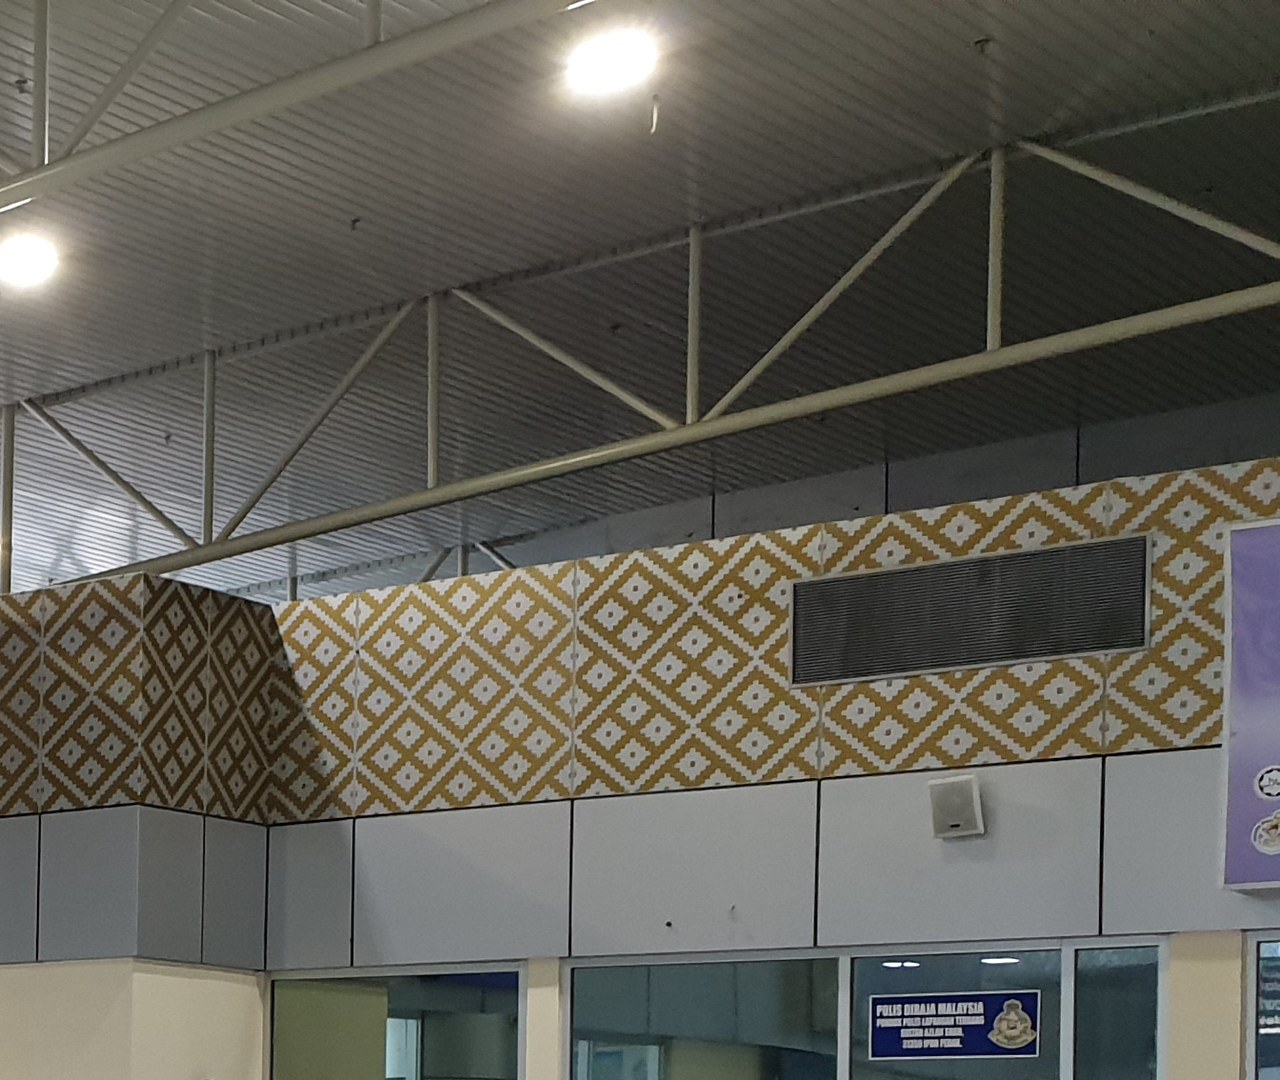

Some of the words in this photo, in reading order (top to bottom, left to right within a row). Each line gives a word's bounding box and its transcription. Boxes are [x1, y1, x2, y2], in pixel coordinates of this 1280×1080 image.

[876, 1004, 903, 1017] POLIS
[904, 1003, 937, 1016] DIRAJA
[937, 1001, 984, 1015] MALAYSIA
